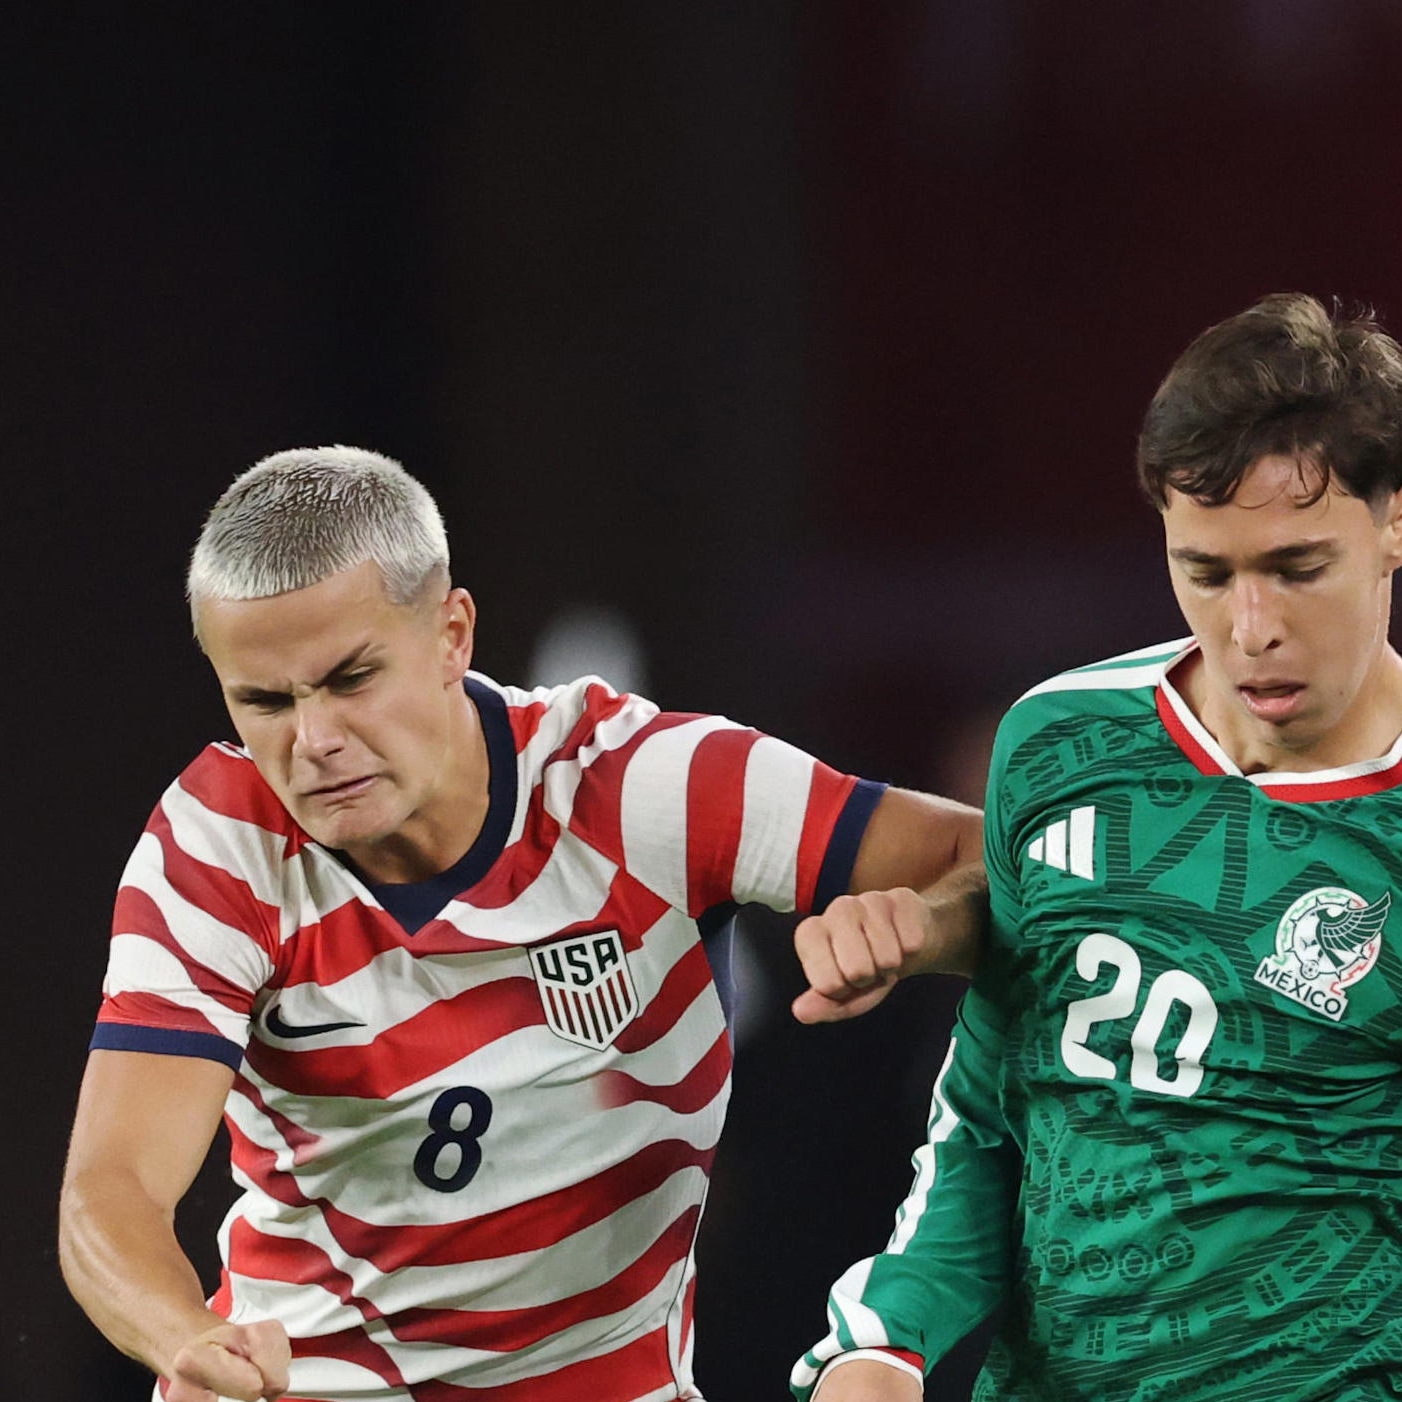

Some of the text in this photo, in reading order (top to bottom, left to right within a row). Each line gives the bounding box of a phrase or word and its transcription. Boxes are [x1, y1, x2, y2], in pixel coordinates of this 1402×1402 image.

[536, 936, 619, 987] USA
[1258, 962, 1342, 1015] MÉXICO
[1060, 932, 1219, 1098] 20
[413, 1083, 493, 1194] 8
